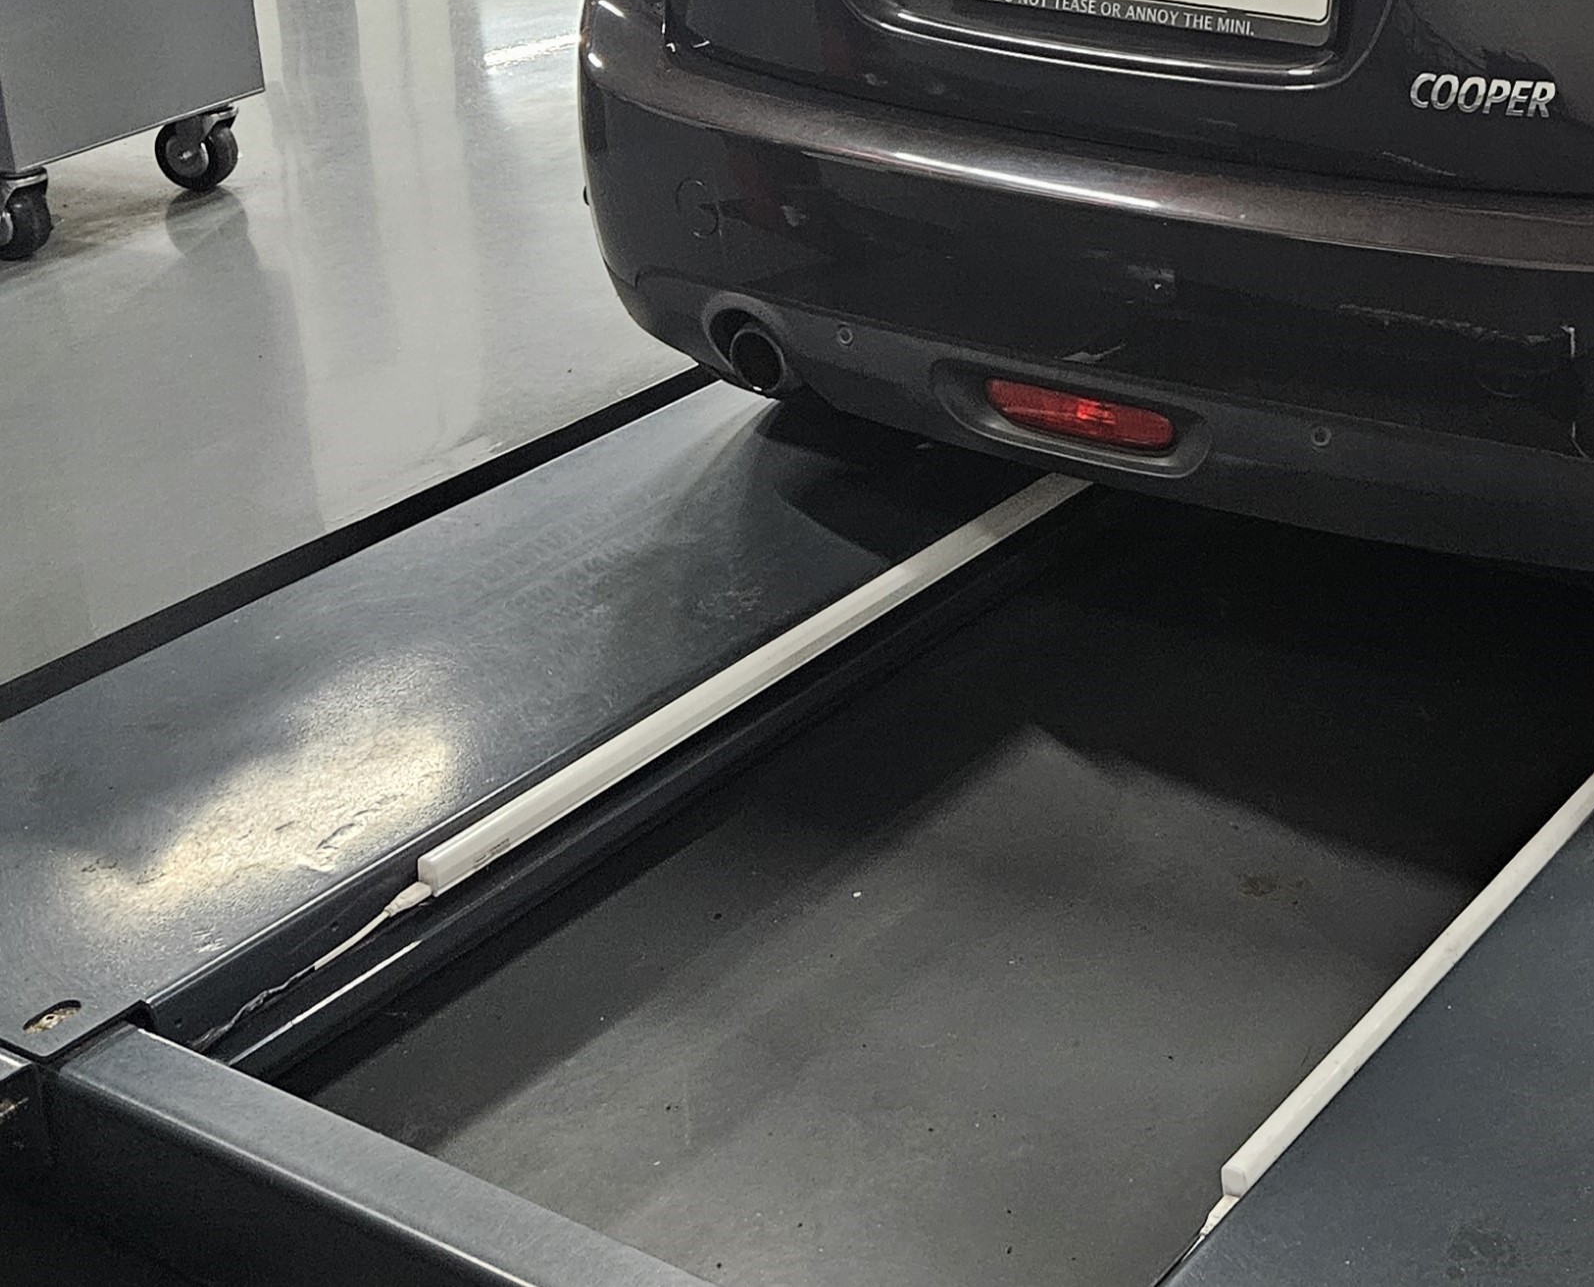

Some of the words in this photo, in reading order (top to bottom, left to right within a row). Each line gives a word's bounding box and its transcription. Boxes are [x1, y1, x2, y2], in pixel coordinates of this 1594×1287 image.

[1100, 1, 1121, 18] OR
[1124, 5, 1180, 26] ANNOY
[1183, 12, 1213, 31] THE
[1216, 17, 1255, 36] MINI.
[1410, 72, 1556, 118] COOPER
